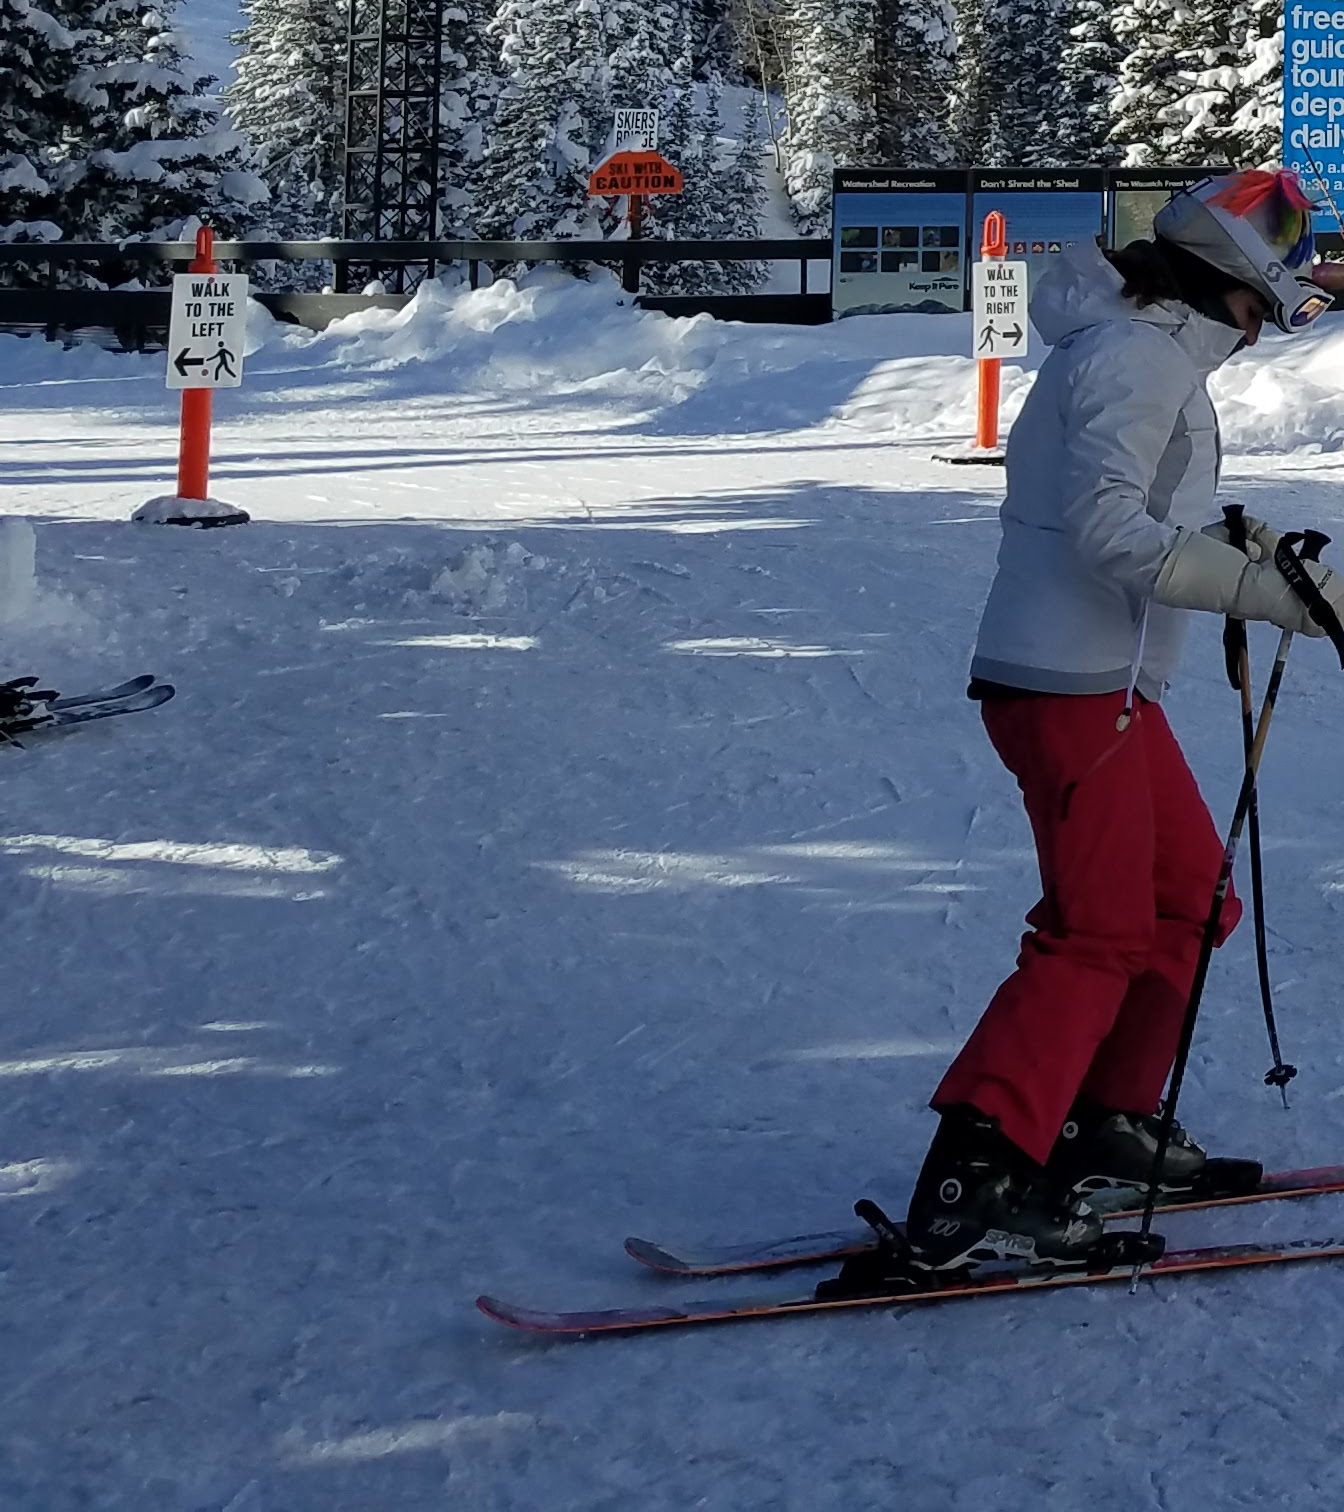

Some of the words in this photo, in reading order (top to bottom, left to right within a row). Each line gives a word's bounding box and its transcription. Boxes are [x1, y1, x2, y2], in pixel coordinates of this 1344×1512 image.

[617, 111, 656, 130] SKIERS
[608, 162, 628, 176] SKI
[633, 161, 663, 175] WITH
[1291, 161, 1323, 174] 9:30
[595, 175, 675, 190] CAUTION
[842, 179, 890, 188] Watershed
[891, 179, 936, 188] Recreation
[981, 180, 1005, 188] Don't
[1007, 179, 1035, 188] Shred
[1036, 179, 1051, 188] the
[1116, 180, 1129, 188] The
[1298, 178, 1330, 191] 0:30
[987, 268, 1015, 281] WALK
[191, 282, 230, 297] WALK
[984, 285, 996, 298] TO
[1000, 285, 1018, 297] THE
[185, 303, 201, 317] TO
[208, 302, 234, 317] THE
[986, 301, 1016, 314] RIGHT
[191, 322, 225, 338] LEFT
